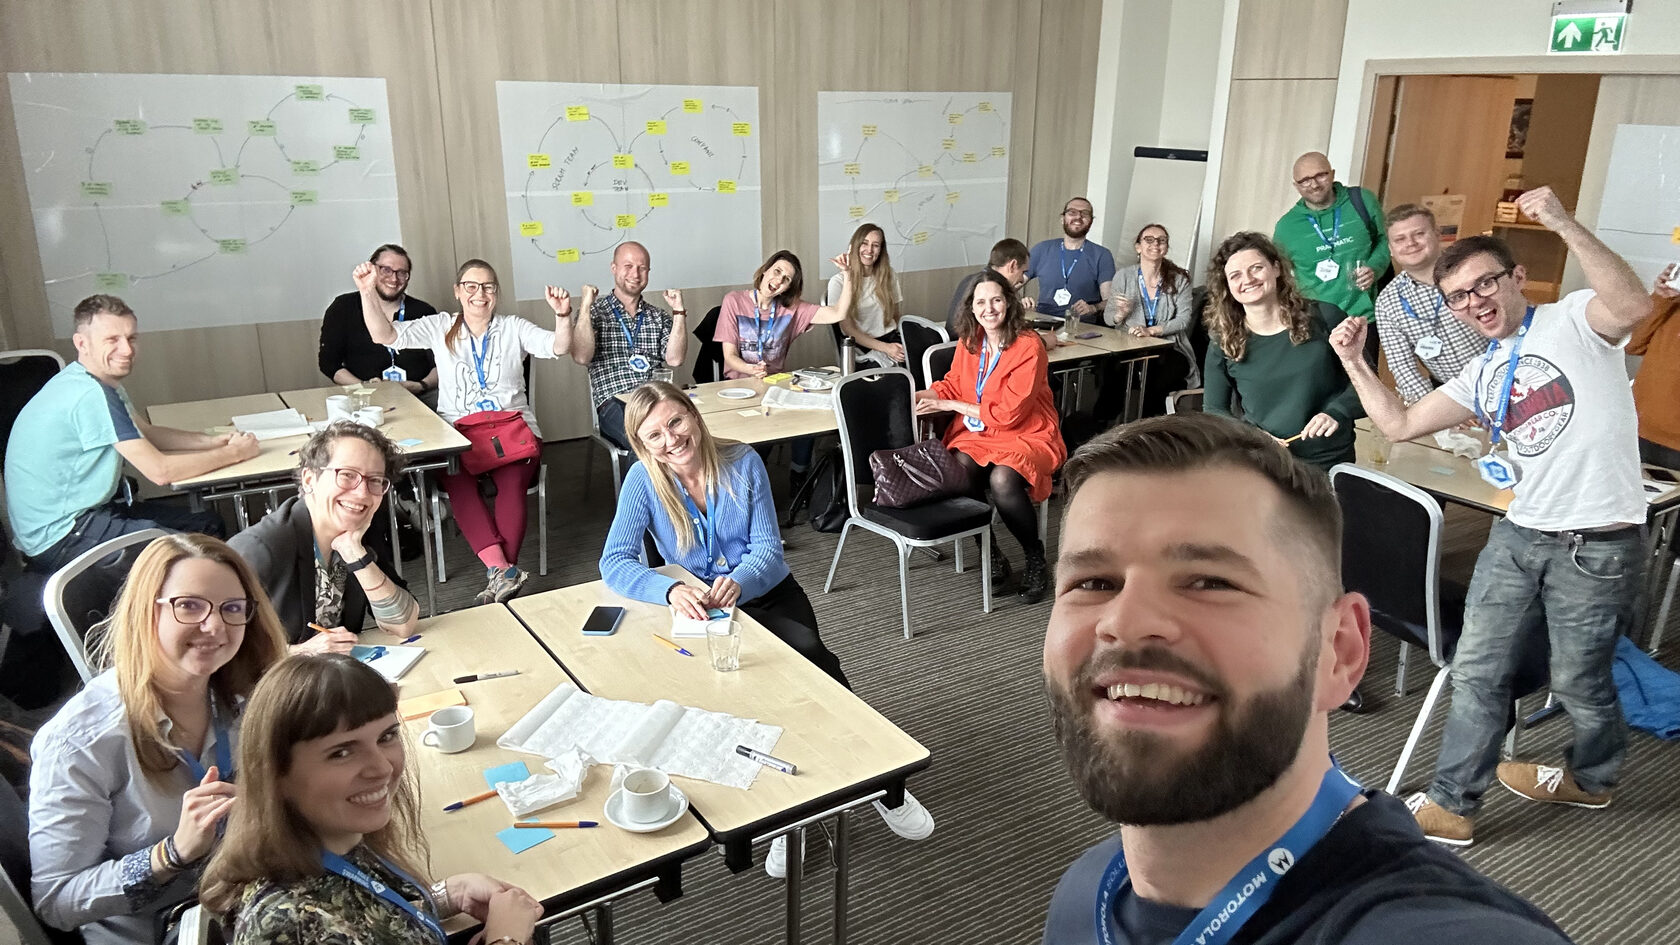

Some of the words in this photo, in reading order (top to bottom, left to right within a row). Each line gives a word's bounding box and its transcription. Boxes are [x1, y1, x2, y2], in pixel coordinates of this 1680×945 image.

[563, 146, 579, 166] TEAM
[1316, 236, 1354, 252] PRAMATIC
[1195, 871, 1268, 945] MOTOROLA
